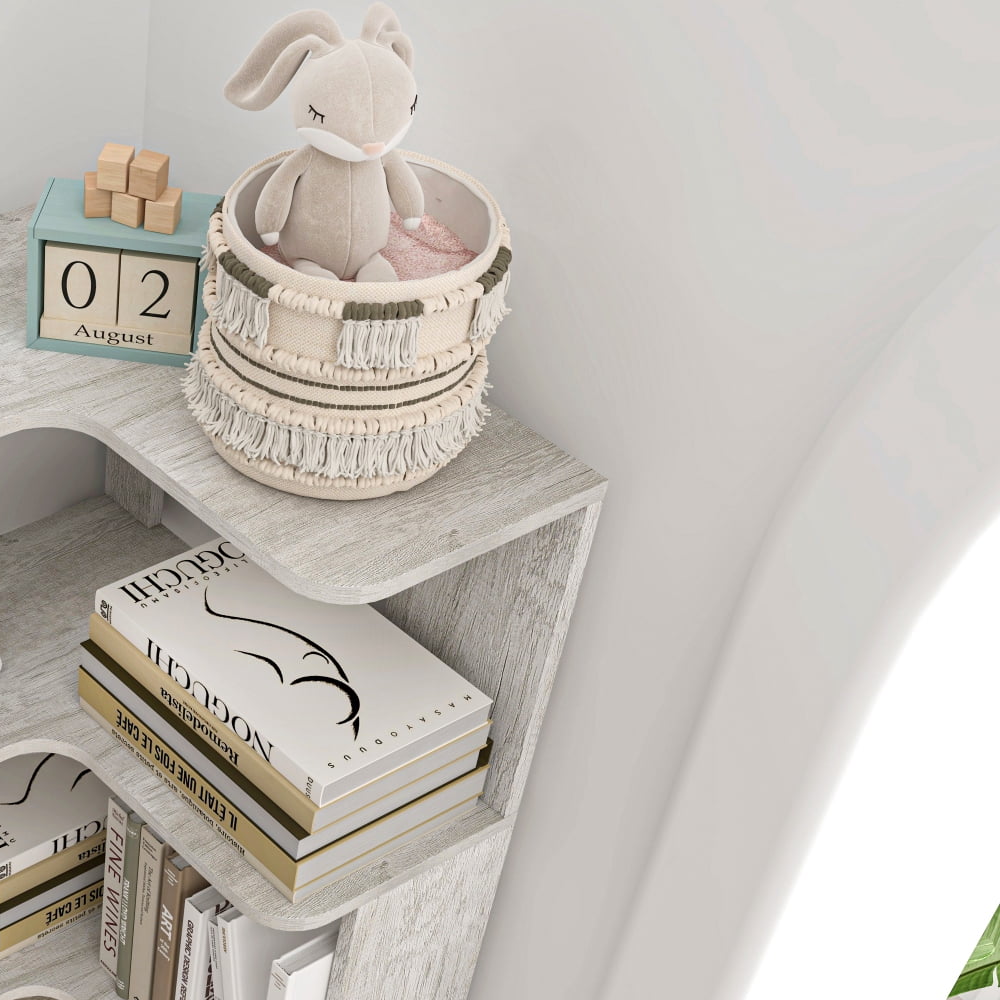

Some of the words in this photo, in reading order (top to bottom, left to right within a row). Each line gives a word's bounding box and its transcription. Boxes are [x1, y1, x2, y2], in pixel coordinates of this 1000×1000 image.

[74, 324, 154, 345] August
[111, 708, 140, 743] CAFÉ
[160, 686, 240, 766] Remodelista
[139, 732, 154, 754] LE
[152, 744, 177, 775] FOIS
[176, 765, 199, 793] UNE
[197, 786, 228, 821] ÉTAIT
[227, 811, 238, 831] IL
[107, 827, 124, 883] FINE
[45, 900, 70, 926] CAFÉ
[74, 893, 86, 910] LE
[104, 886, 120, 958] WINES
[160, 904, 174, 940] ART
[183, 919, 193, 955] GRAPHIC
[180, 955, 190, 984] DESIGN
